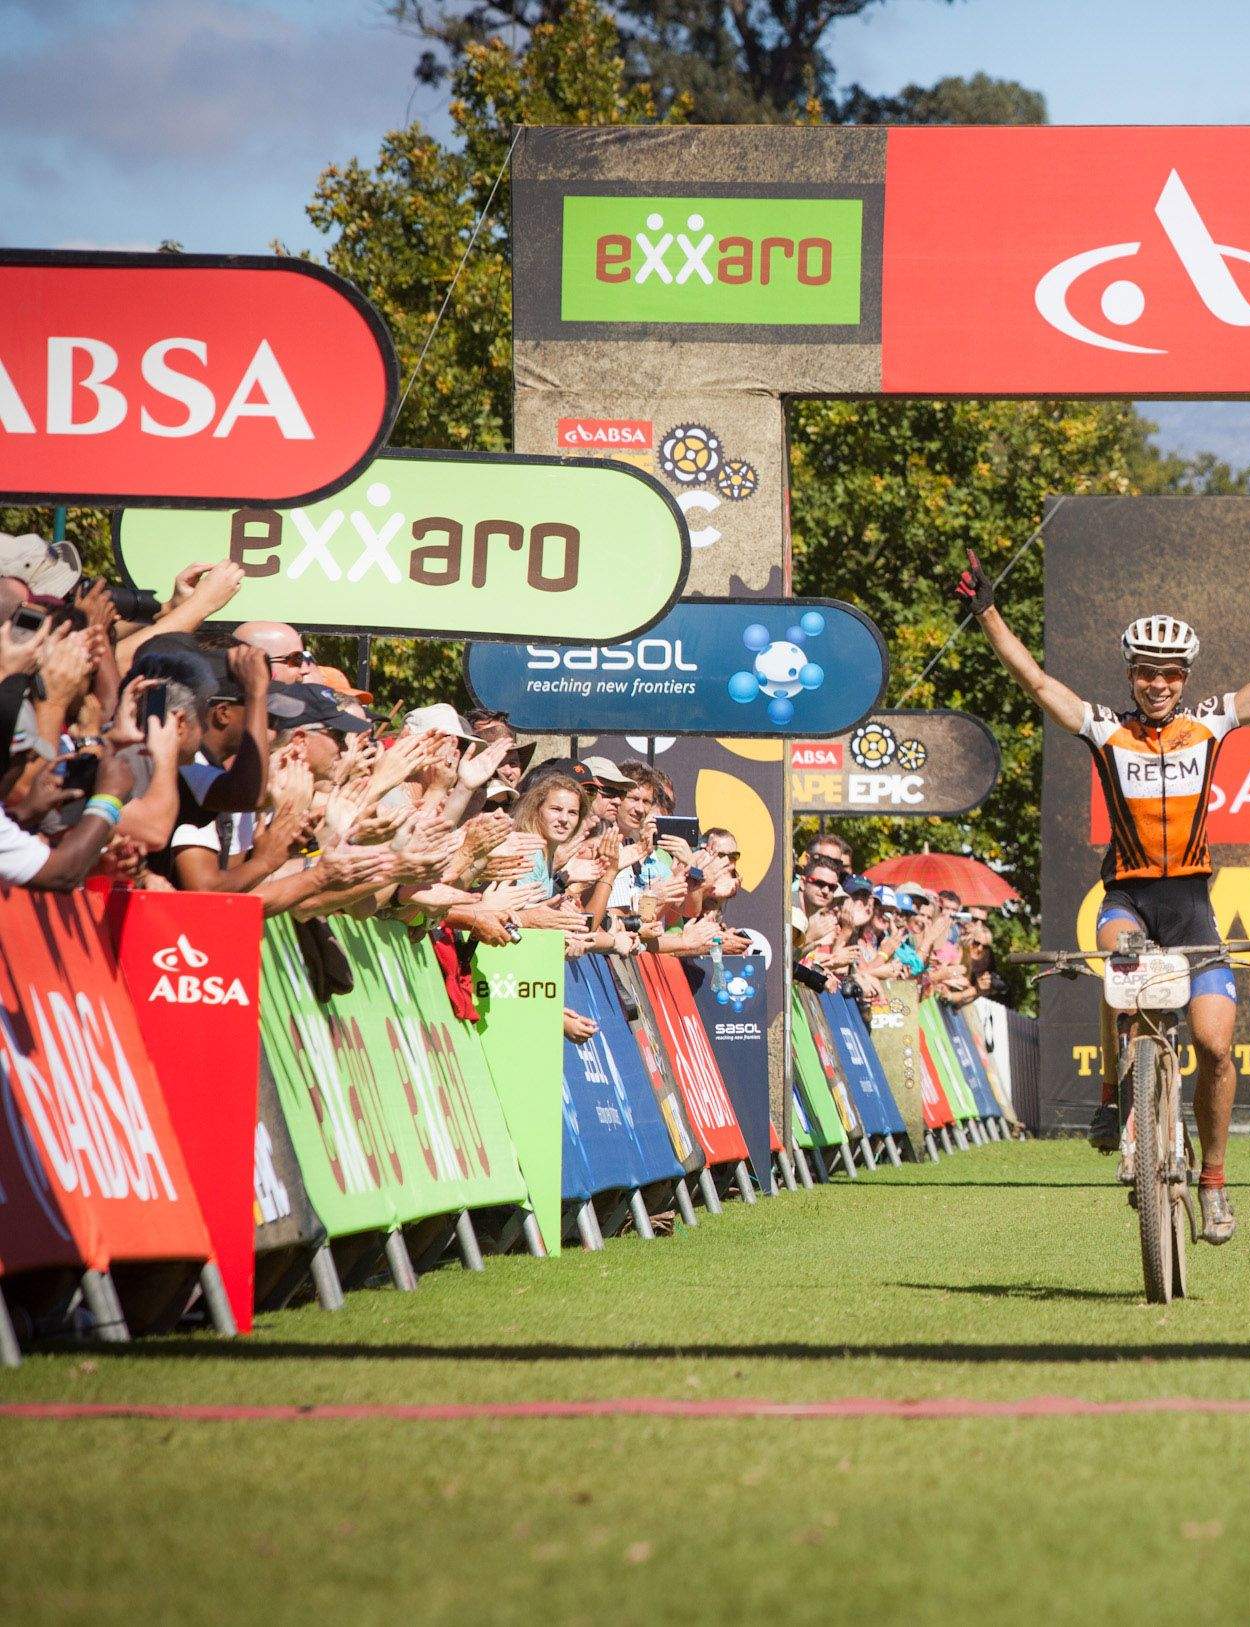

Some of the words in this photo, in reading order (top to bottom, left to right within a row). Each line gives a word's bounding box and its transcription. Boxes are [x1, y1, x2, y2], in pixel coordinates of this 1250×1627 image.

[595, 213, 832, 286] exxaro
[594, 427, 646, 443] ABSA
[230, 482, 580, 592] exxaro
[527, 677, 592, 697] reaching
[596, 681, 628, 693] new
[631, 678, 696, 697] frontiers
[792, 750, 838, 765] ABSA
[1126, 757, 1199, 782] RECM
[848, 775, 925, 804] EPIC
[148, 974, 250, 1006] ABSA
[476, 973, 557, 999] exxaro
[871, 1013, 904, 1029] EPIC
